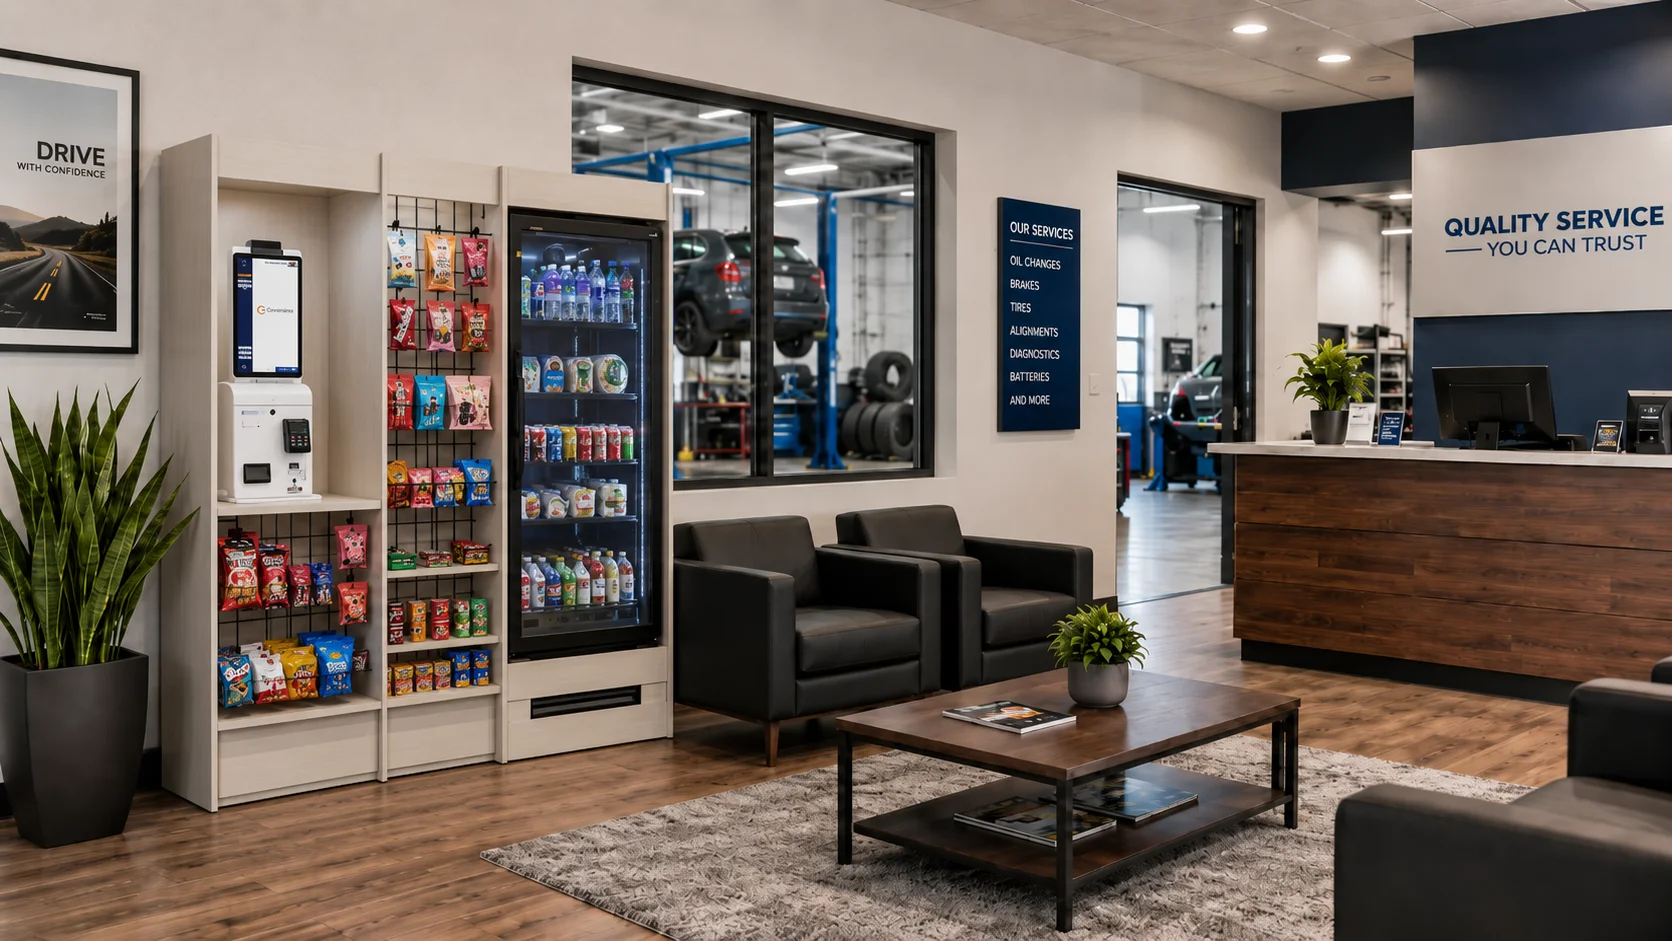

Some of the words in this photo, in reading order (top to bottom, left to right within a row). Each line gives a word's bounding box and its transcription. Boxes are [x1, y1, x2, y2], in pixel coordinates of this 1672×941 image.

[37, 141, 105, 166] DRIVE
[17, 162, 42, 172] WITH
[45, 165, 106, 179] CONFIDENCE
[1445, 213, 1549, 237] QUALITY
[1556, 206, 1664, 230] SERVICE
[1010, 222, 1029, 235] OUR
[1032, 224, 1073, 241] SERVICES
[1487, 240, 1527, 256] YOU
[1534, 238, 1575, 254] CAN
[1581, 235, 1647, 252] TRUST
[1010, 256, 1023, 267] OIL
[1025, 257, 1060, 271] CHANGES
[1011, 279, 1039, 291] BRAKES
[1010, 302, 1031, 314] TIRES
[1010, 326, 1058, 338] ALIGNMENTS
[1010, 349, 1059, 360] DIAGNOSTICS
[1010, 372, 1049, 382] BATTERIES
[1010, 395, 1026, 406] AND
[1029, 395, 1050, 406] MORE
